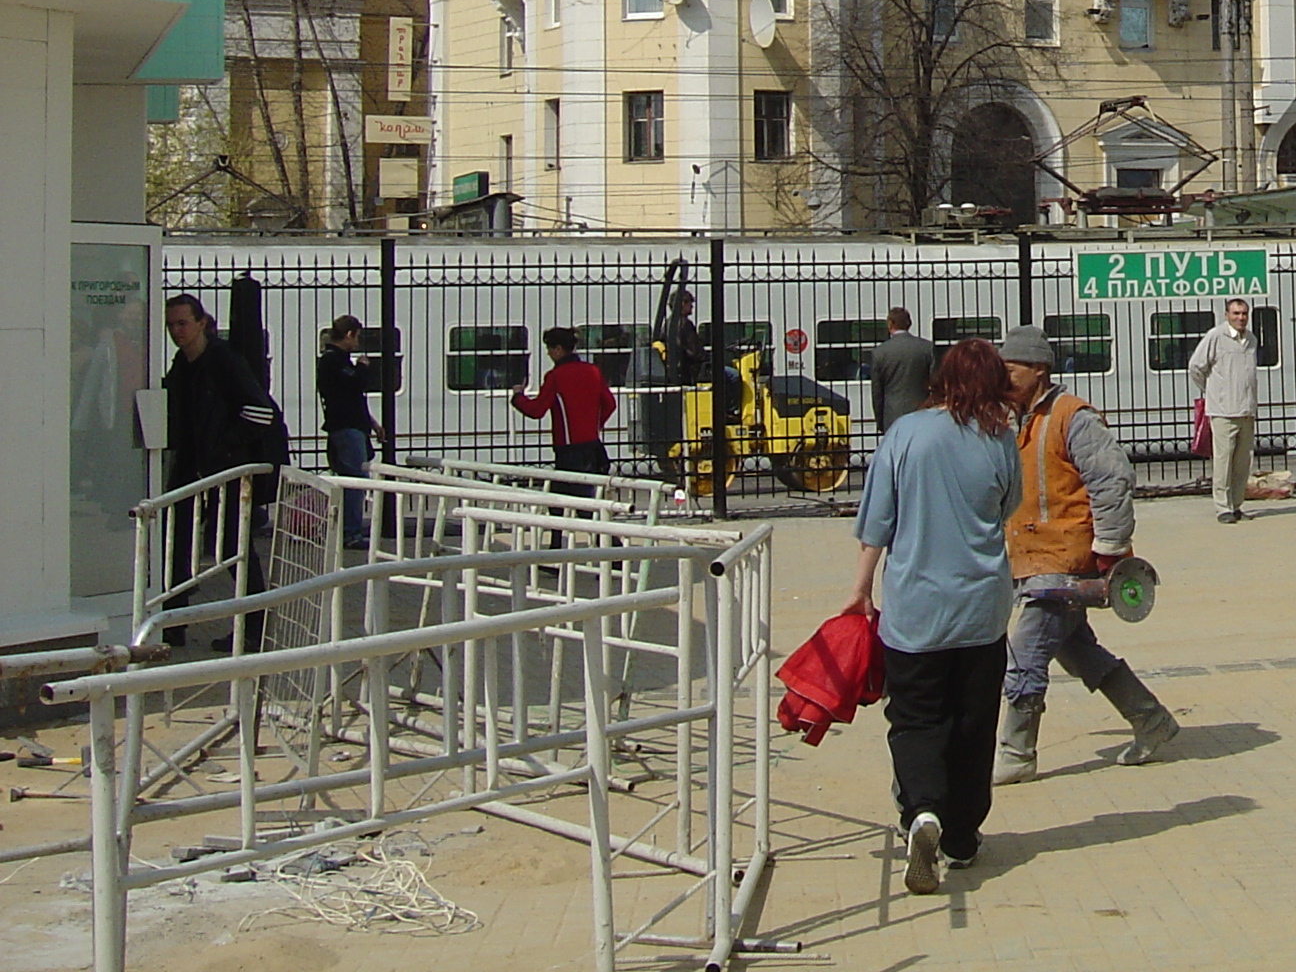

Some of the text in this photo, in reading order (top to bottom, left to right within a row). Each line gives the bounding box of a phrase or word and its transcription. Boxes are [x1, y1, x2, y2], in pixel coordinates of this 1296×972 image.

[1108, 252, 1238, 278] 2 ПУТЬ
[78, 280, 141, 291] ПРИГОРОДНЫМ
[1083, 277, 1263, 297] 4 ПЛАТФОРМА
[86, 294, 126, 305] ПОЕЗДАМ
